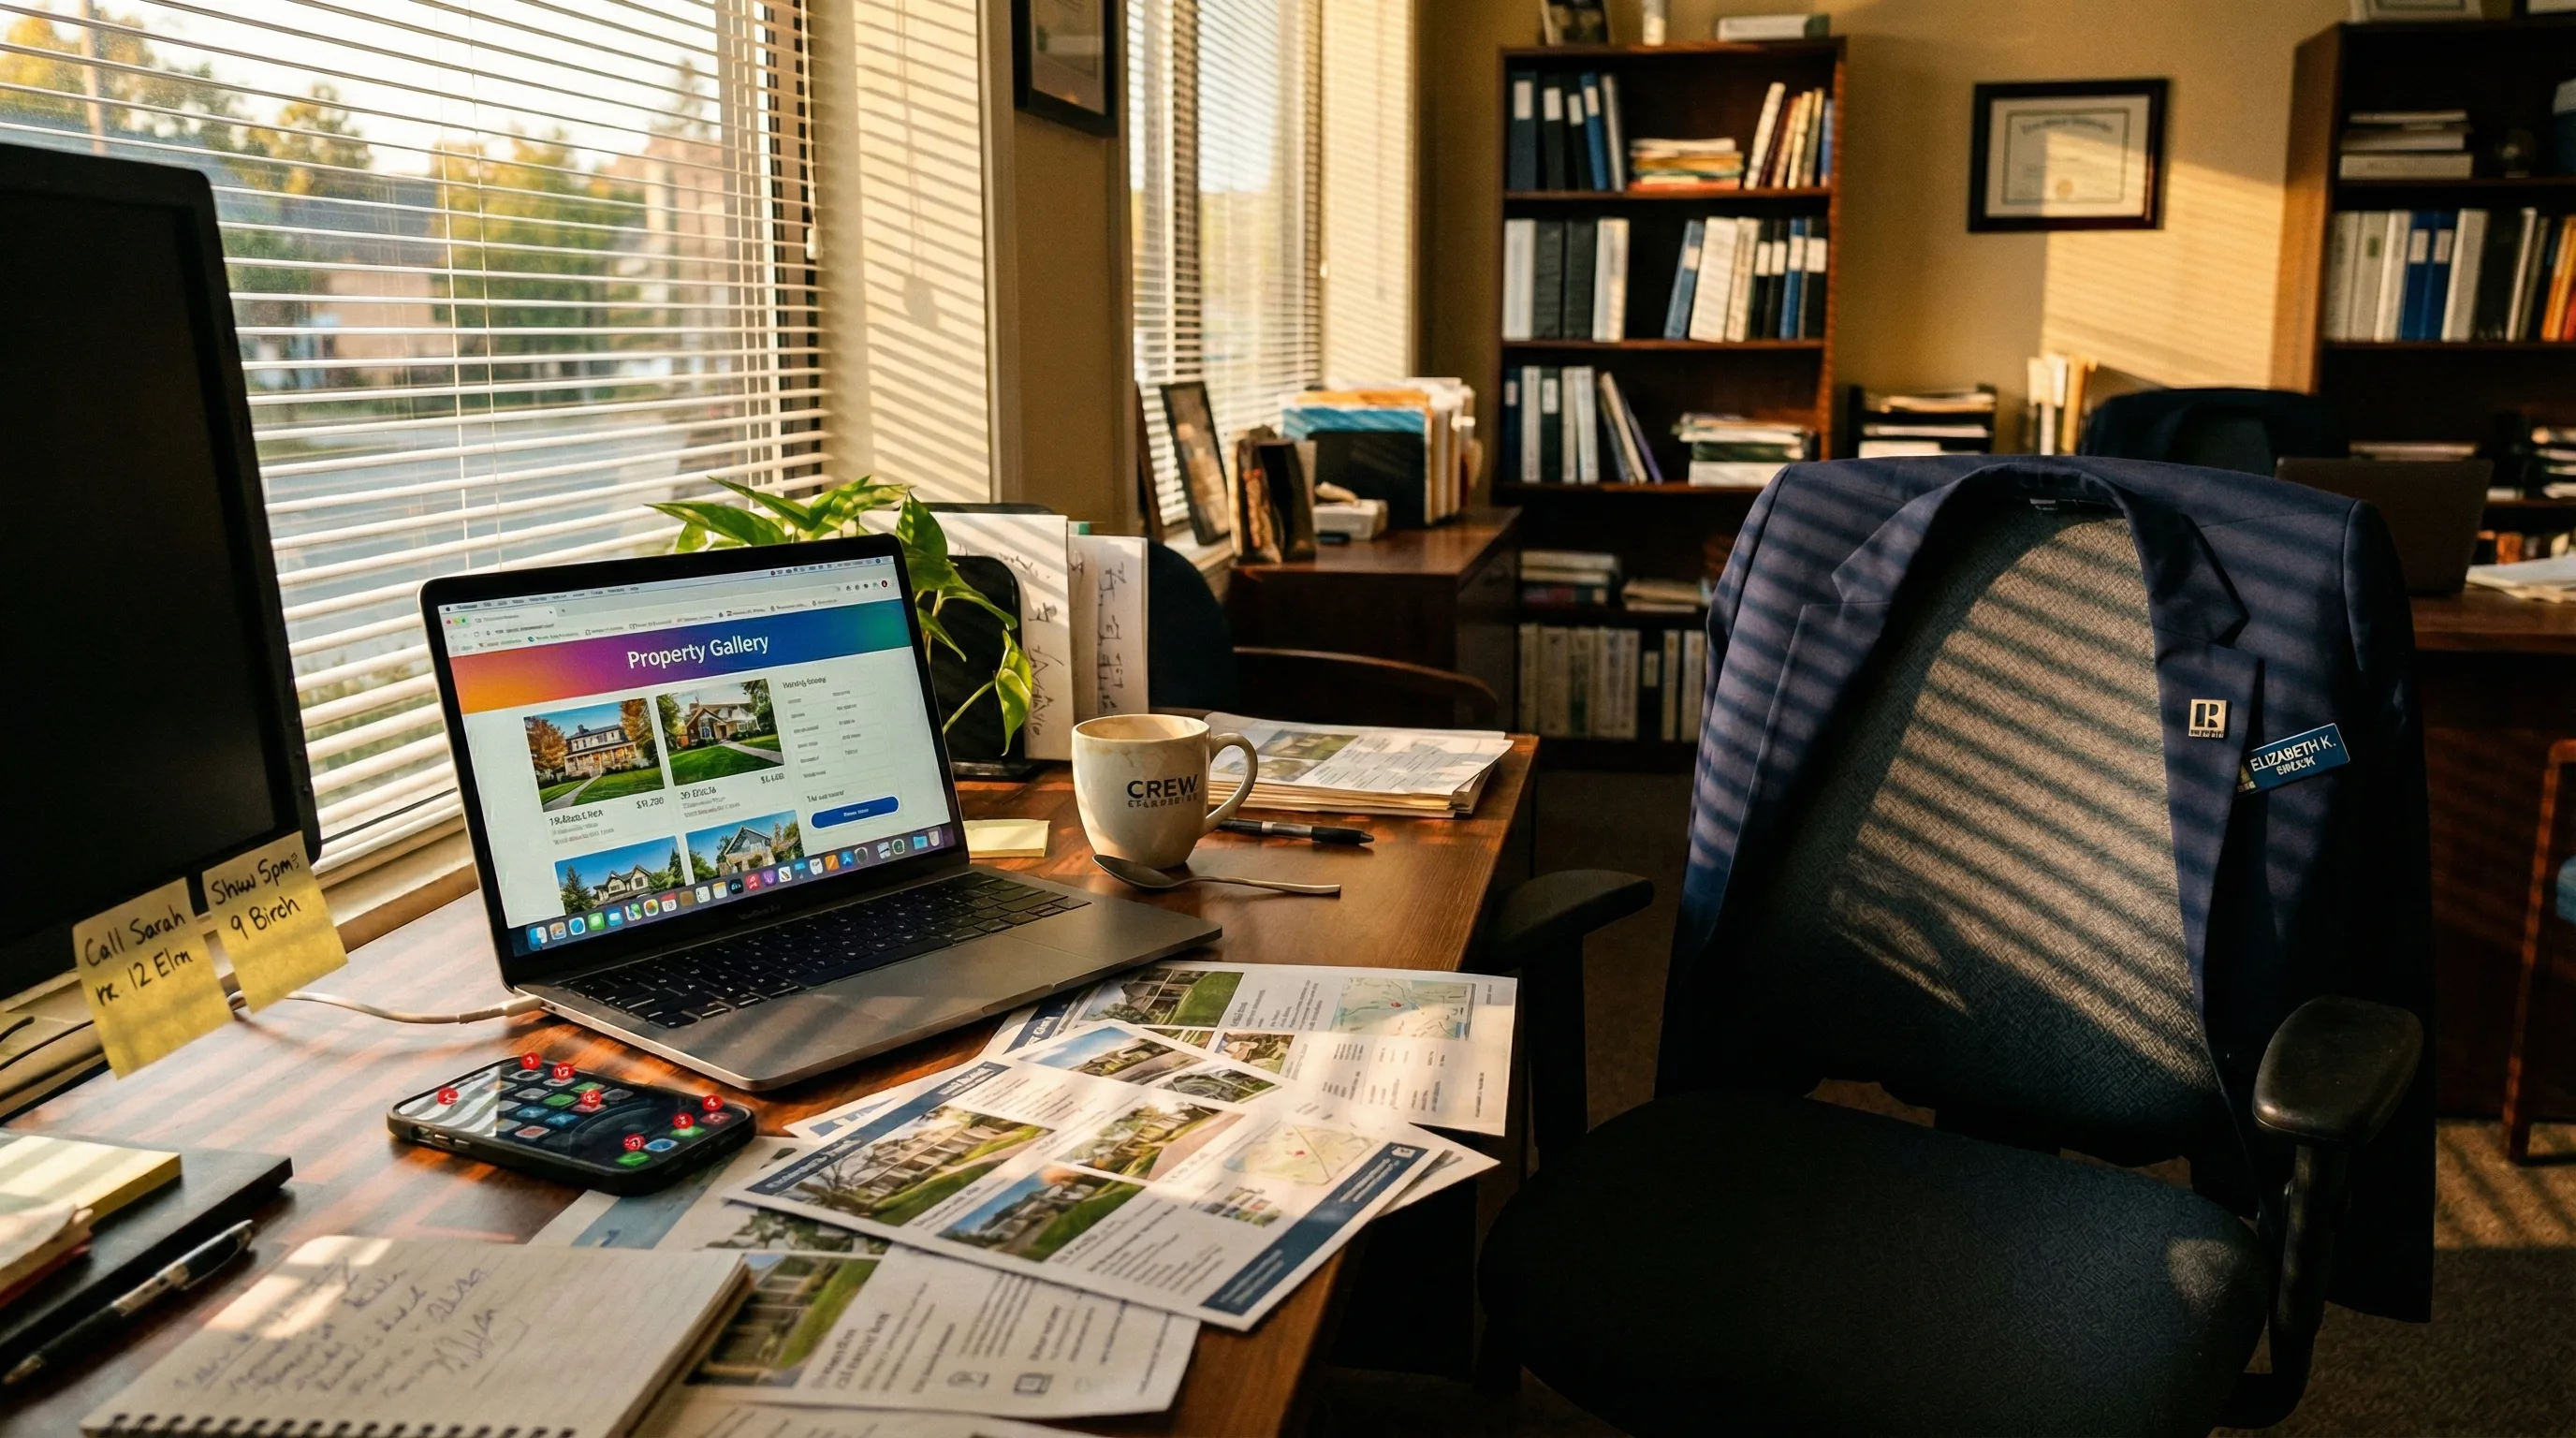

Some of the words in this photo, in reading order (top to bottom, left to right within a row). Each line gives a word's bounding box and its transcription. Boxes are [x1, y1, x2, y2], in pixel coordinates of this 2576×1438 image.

[627, 643, 706, 669] Property
[710, 635, 768, 657] Gallery
[2249, 739, 2320, 772] ELIZABETH
[2320, 735, 2337, 750] K.
[1127, 774, 1198, 800] CREW
[85, 927, 125, 967] Call
[129, 904, 185, 946] Sarah
[230, 915, 249, 940] 9
[249, 896, 301, 931] Birch
[127, 962, 153, 990] 12
[154, 947, 193, 978] Elm
